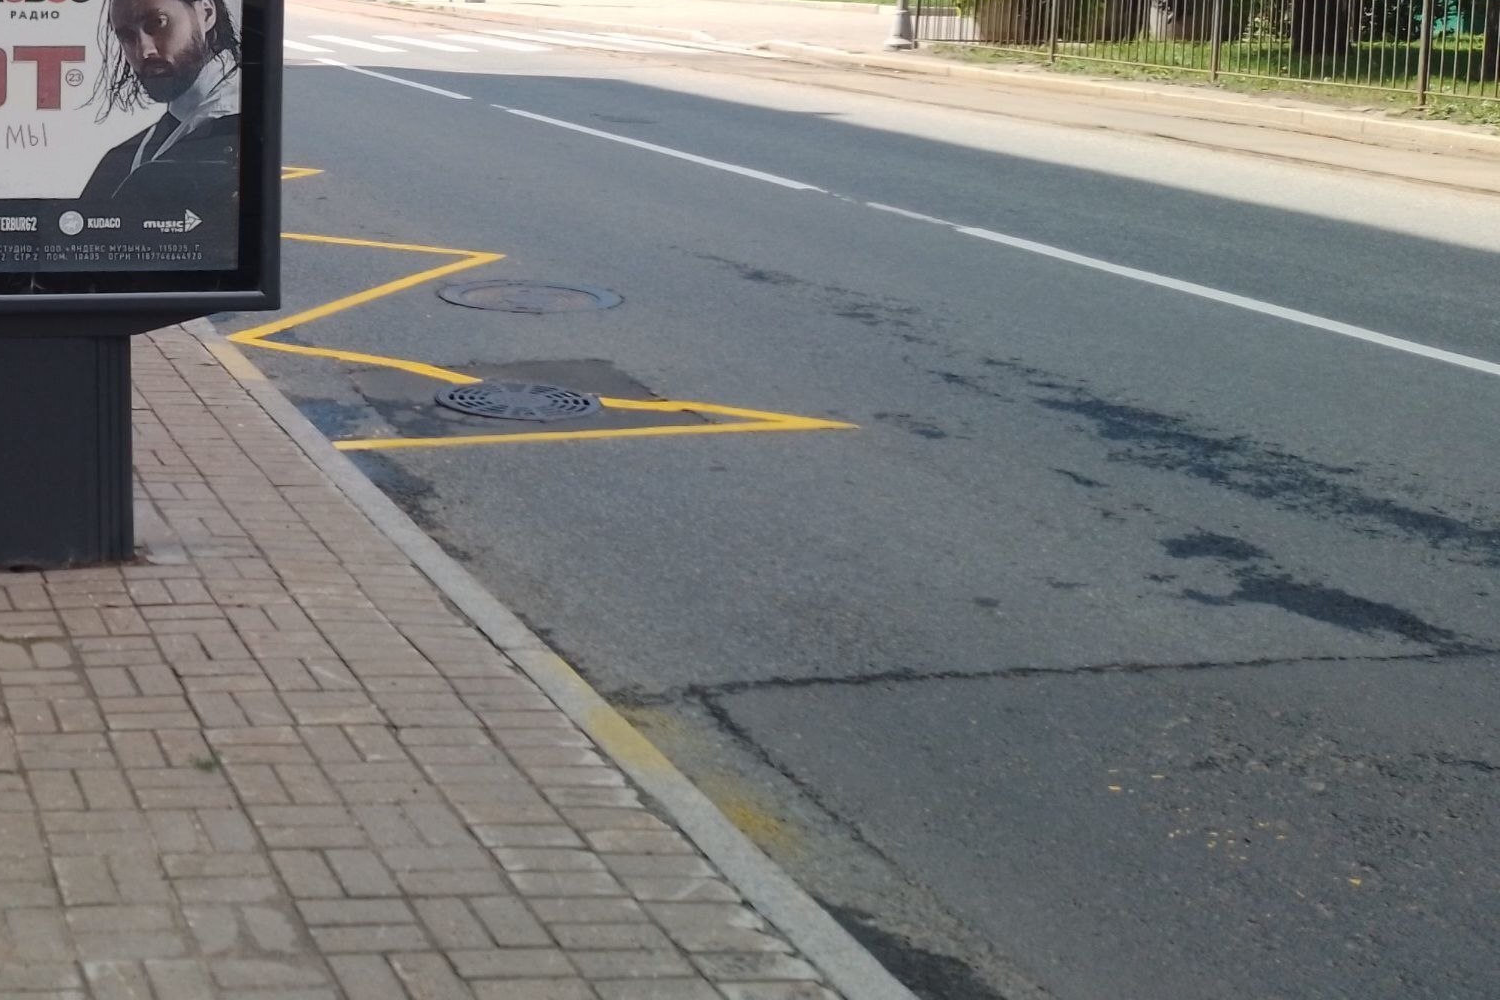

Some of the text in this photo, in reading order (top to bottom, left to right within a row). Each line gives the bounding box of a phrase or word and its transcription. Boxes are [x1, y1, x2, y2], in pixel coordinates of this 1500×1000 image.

[10, 10, 61, 21] РАДИО
[68, 72, 83, 83] 23
[5, 122, 48, 150] МЫ
[87, 217, 121, 229] KUDAGO
